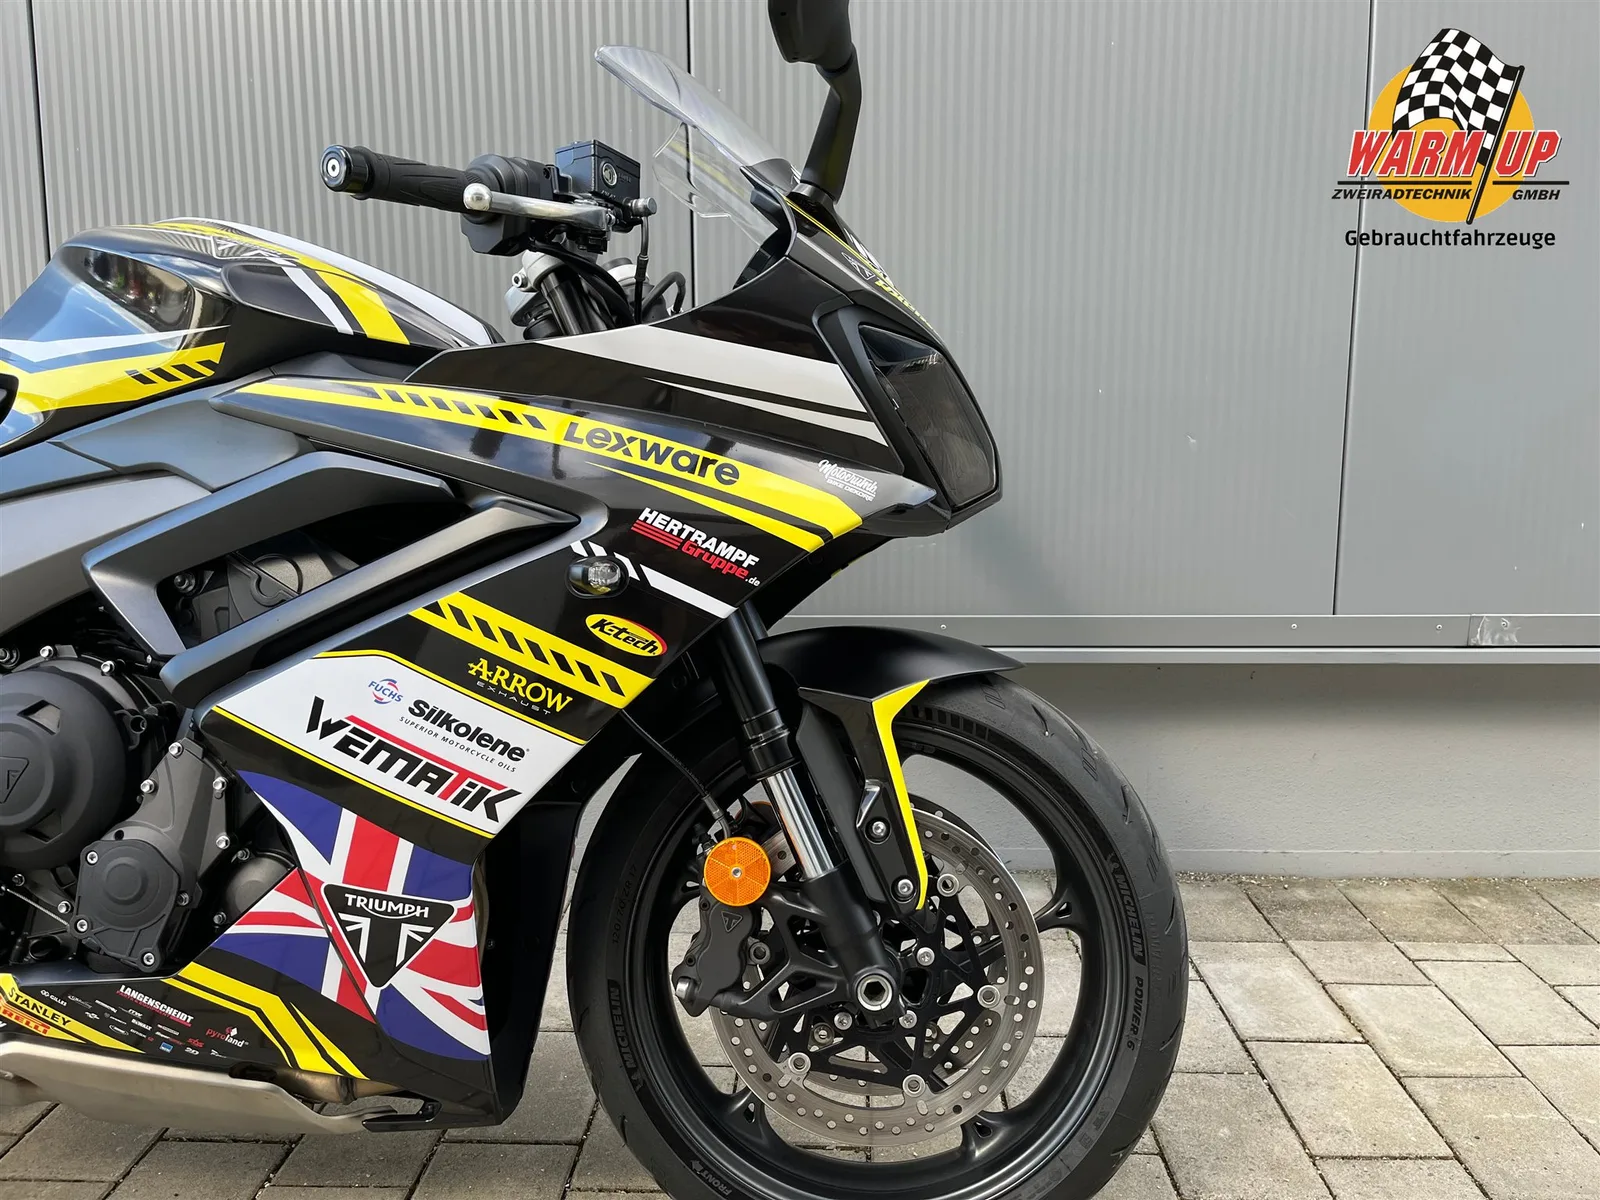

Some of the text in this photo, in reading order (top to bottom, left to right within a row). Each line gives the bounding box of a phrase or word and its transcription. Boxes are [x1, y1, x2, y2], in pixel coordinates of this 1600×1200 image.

[563, 420, 740, 486] Lexware
[637, 506, 760, 569] HERTRAMPF
[368, 679, 404, 703] FUCHS
[467, 656, 574, 714] ARROW
[476, 680, 552, 715] EXHAUST
[399, 716, 517, 773] SUPERIOR MOTORCYCLE OILS
[407, 698, 528, 763] Silkolene
[344, 893, 430, 919] TRIUMPH
[1114, 873, 1145, 963] MICHELIN
[0, 1004, 51, 1035] RELLI
[9, 987, 71, 1026] STANLEY
[120, 984, 194, 1024] LANGENSCHEIDT
[609, 986, 637, 1069] MICHELIN
[1128, 976, 1144, 1036] POWER
[698, 1168, 733, 1197] FRONT
